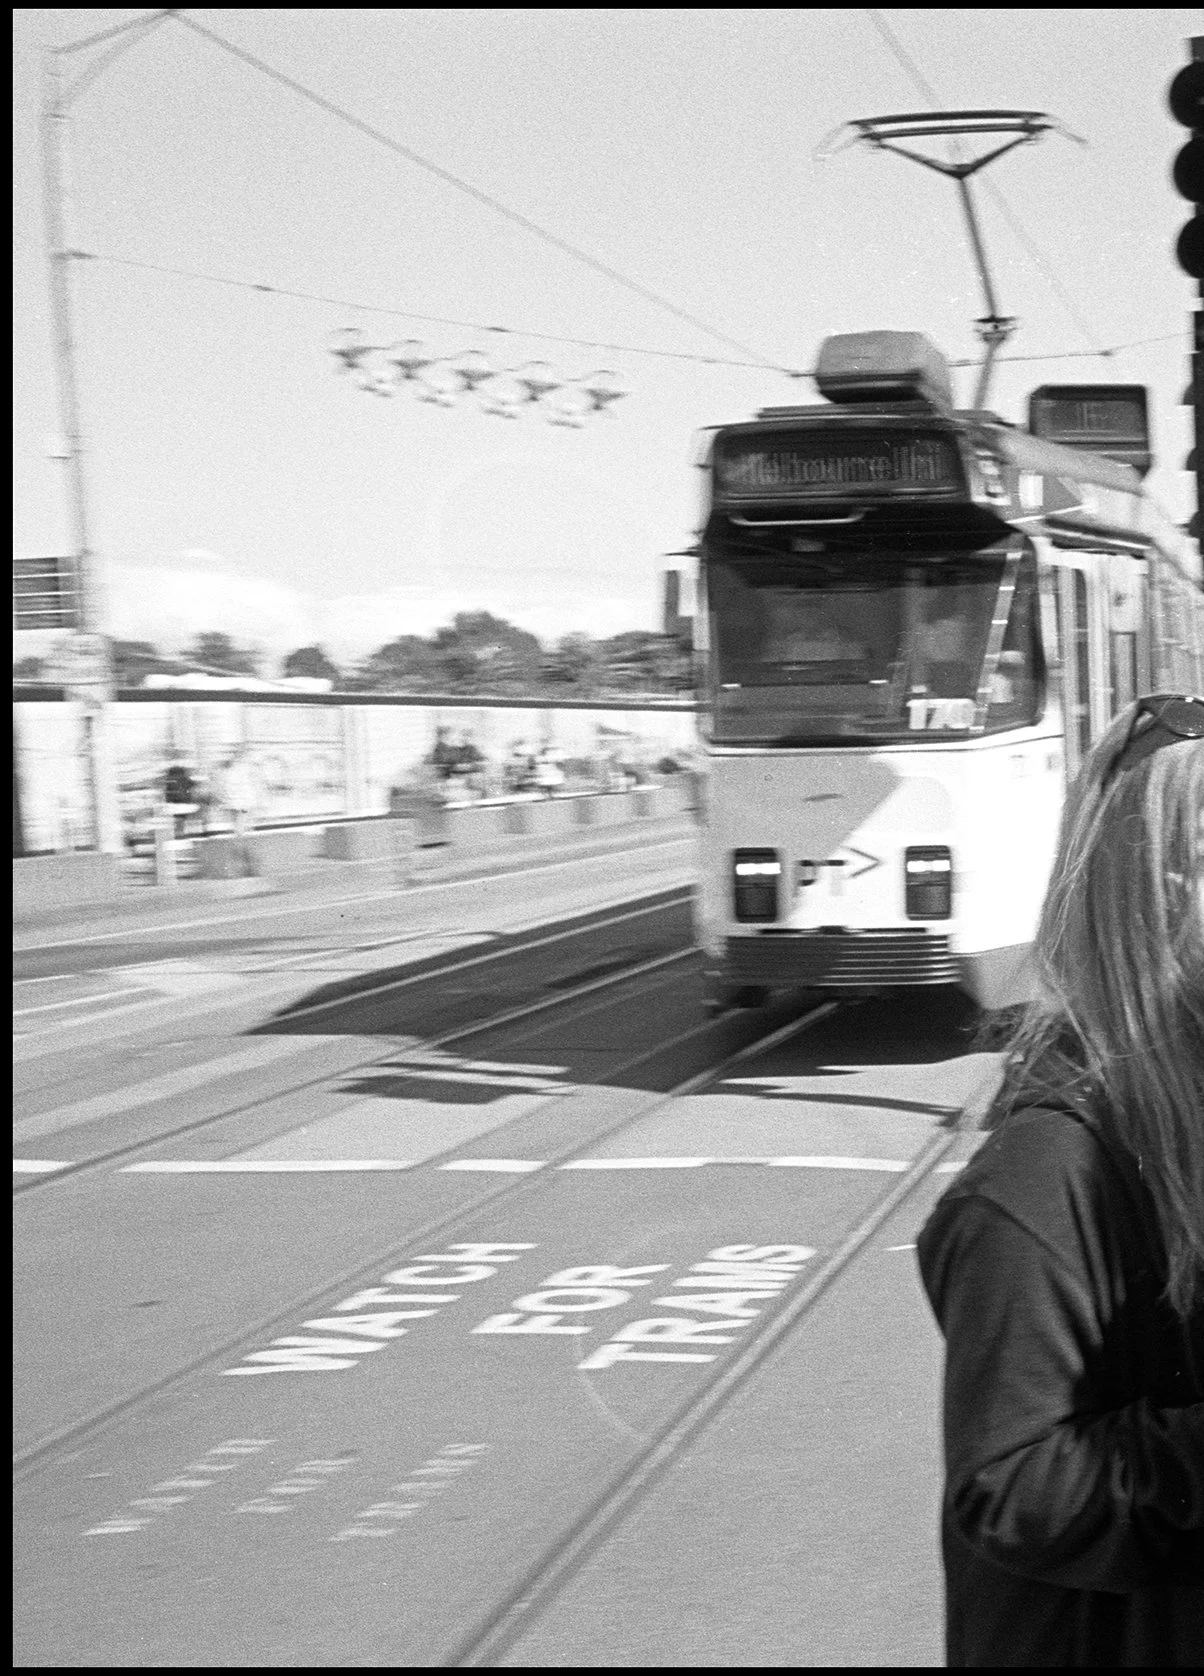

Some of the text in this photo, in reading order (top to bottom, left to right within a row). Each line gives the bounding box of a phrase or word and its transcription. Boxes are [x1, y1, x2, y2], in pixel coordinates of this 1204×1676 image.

[217, 1242, 538, 1377] WATCH
[469, 1263, 672, 1335] FOR
[576, 1243, 817, 1370] TRAMS
